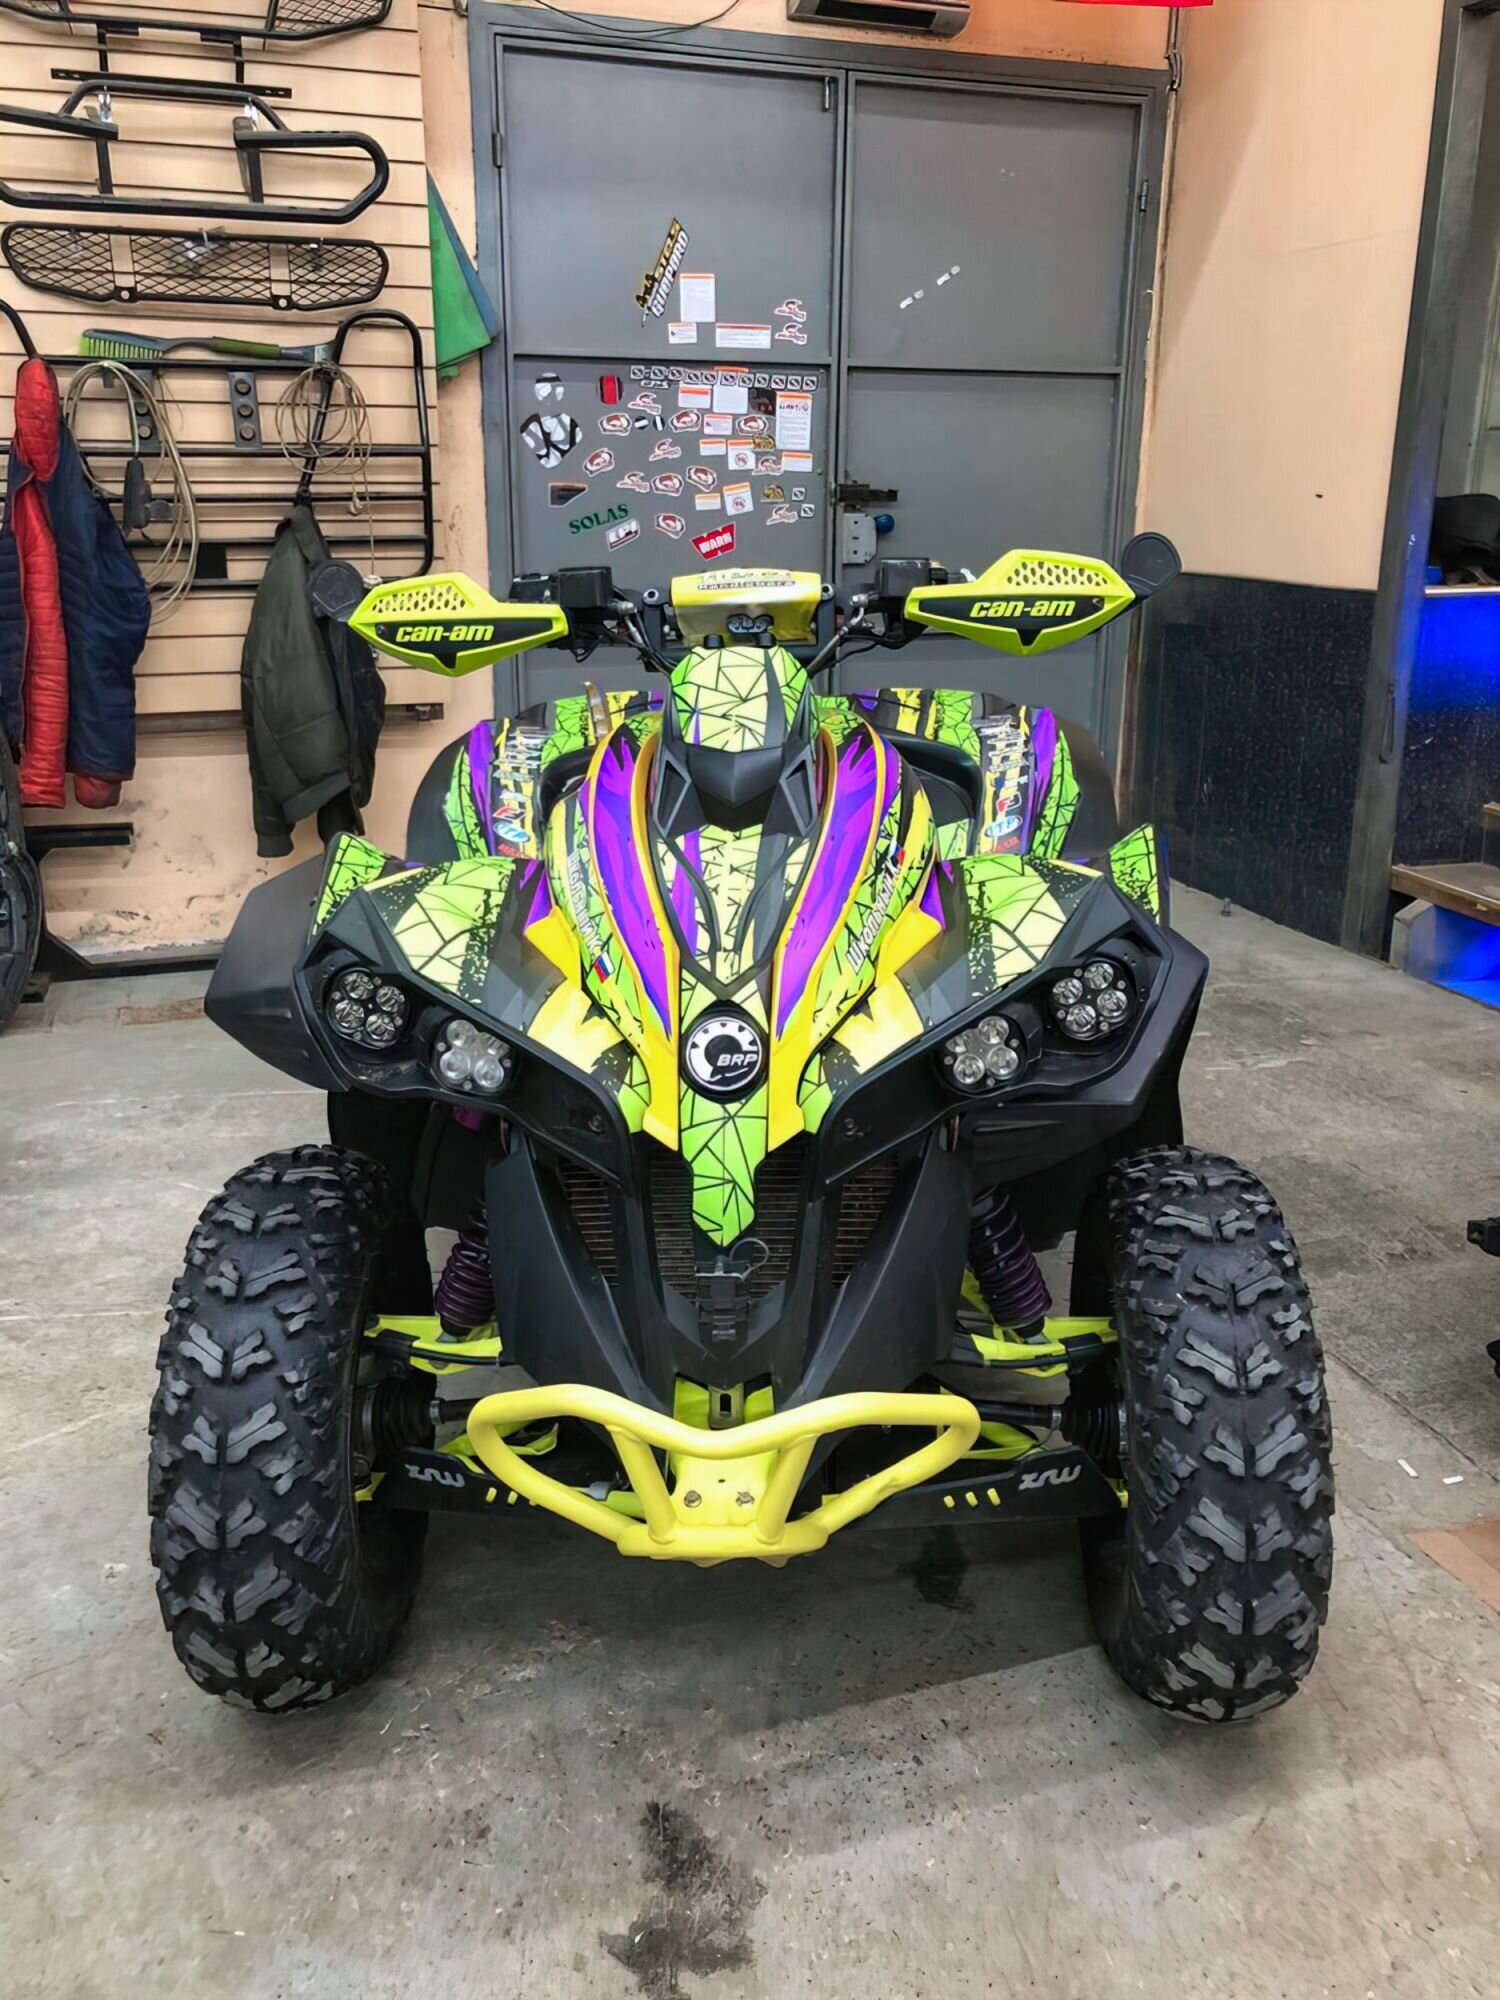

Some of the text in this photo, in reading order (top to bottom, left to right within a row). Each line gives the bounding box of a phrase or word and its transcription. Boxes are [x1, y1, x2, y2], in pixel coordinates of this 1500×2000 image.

[569, 503, 629, 534] SOLAS
[699, 532, 733, 554] WARN
[969, 600, 1076, 618] can-am
[396, 625, 494, 642] can-am
[717, 1054, 758, 1066] BRP
